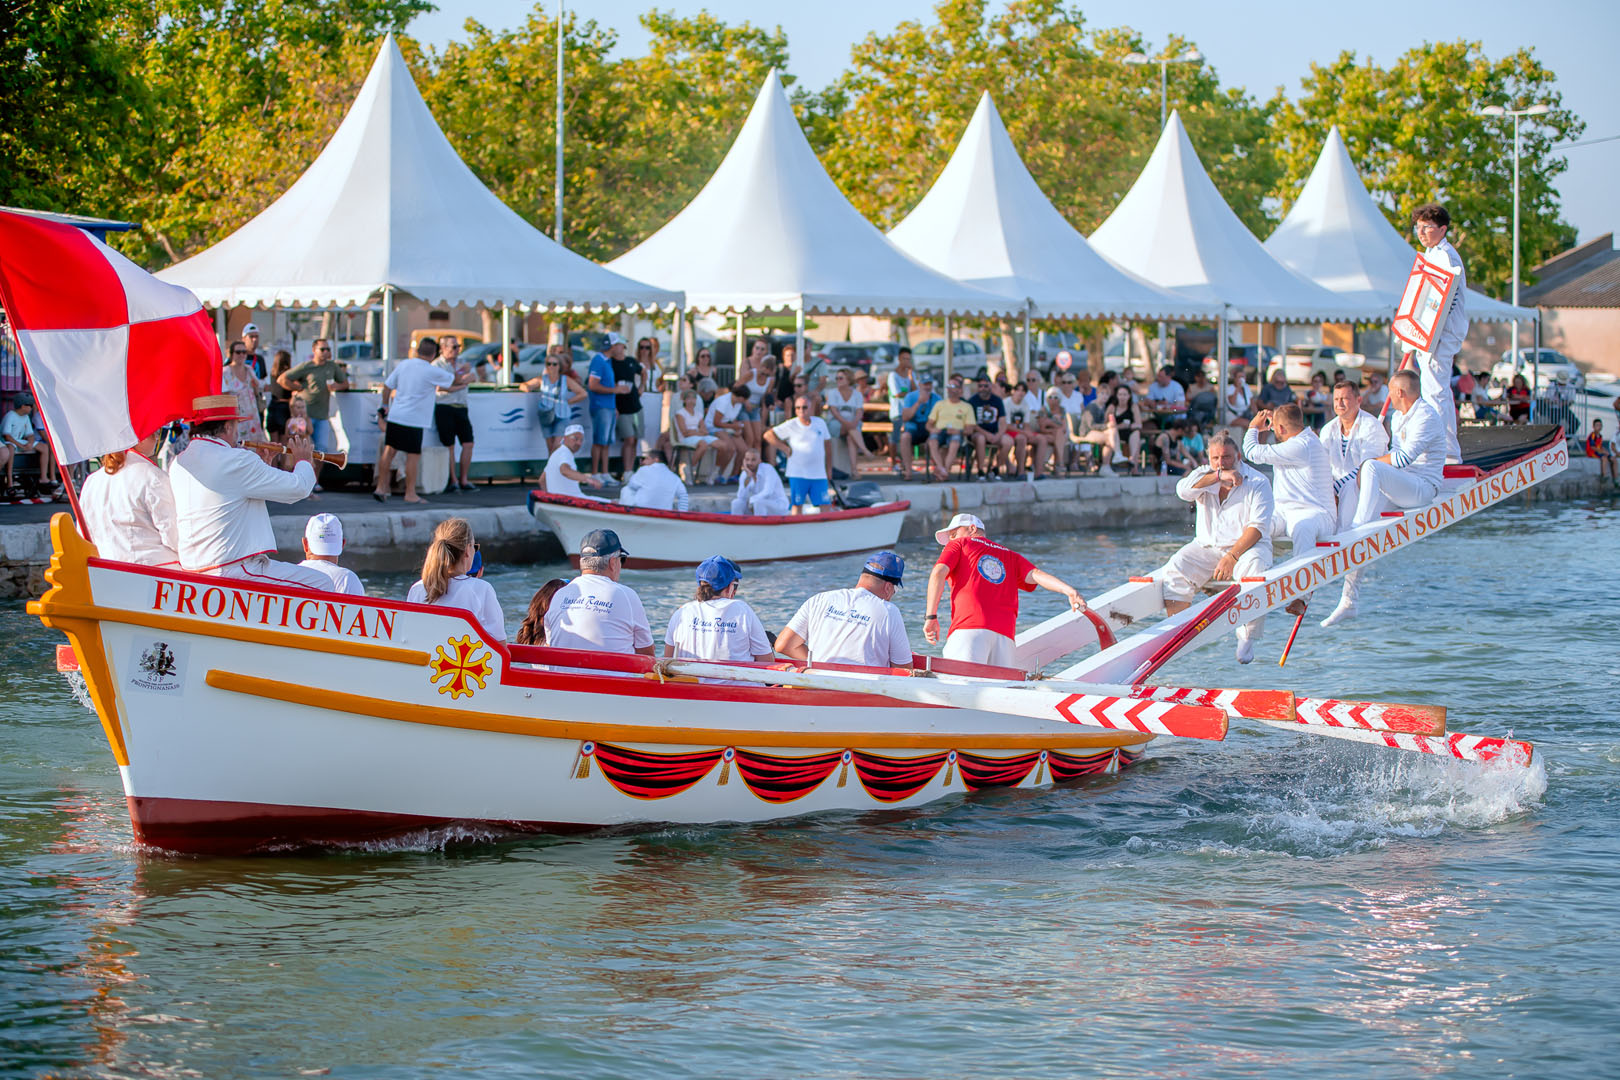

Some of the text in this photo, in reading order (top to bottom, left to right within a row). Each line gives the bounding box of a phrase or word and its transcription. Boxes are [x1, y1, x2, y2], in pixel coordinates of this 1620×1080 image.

[1264, 459, 1538, 609] FRONTIGNAN SON MUSCAT
[151, 579, 398, 641] FRONTIGNAN
[585, 595, 614, 609] Rames
[692, 617, 712, 627] Msca
